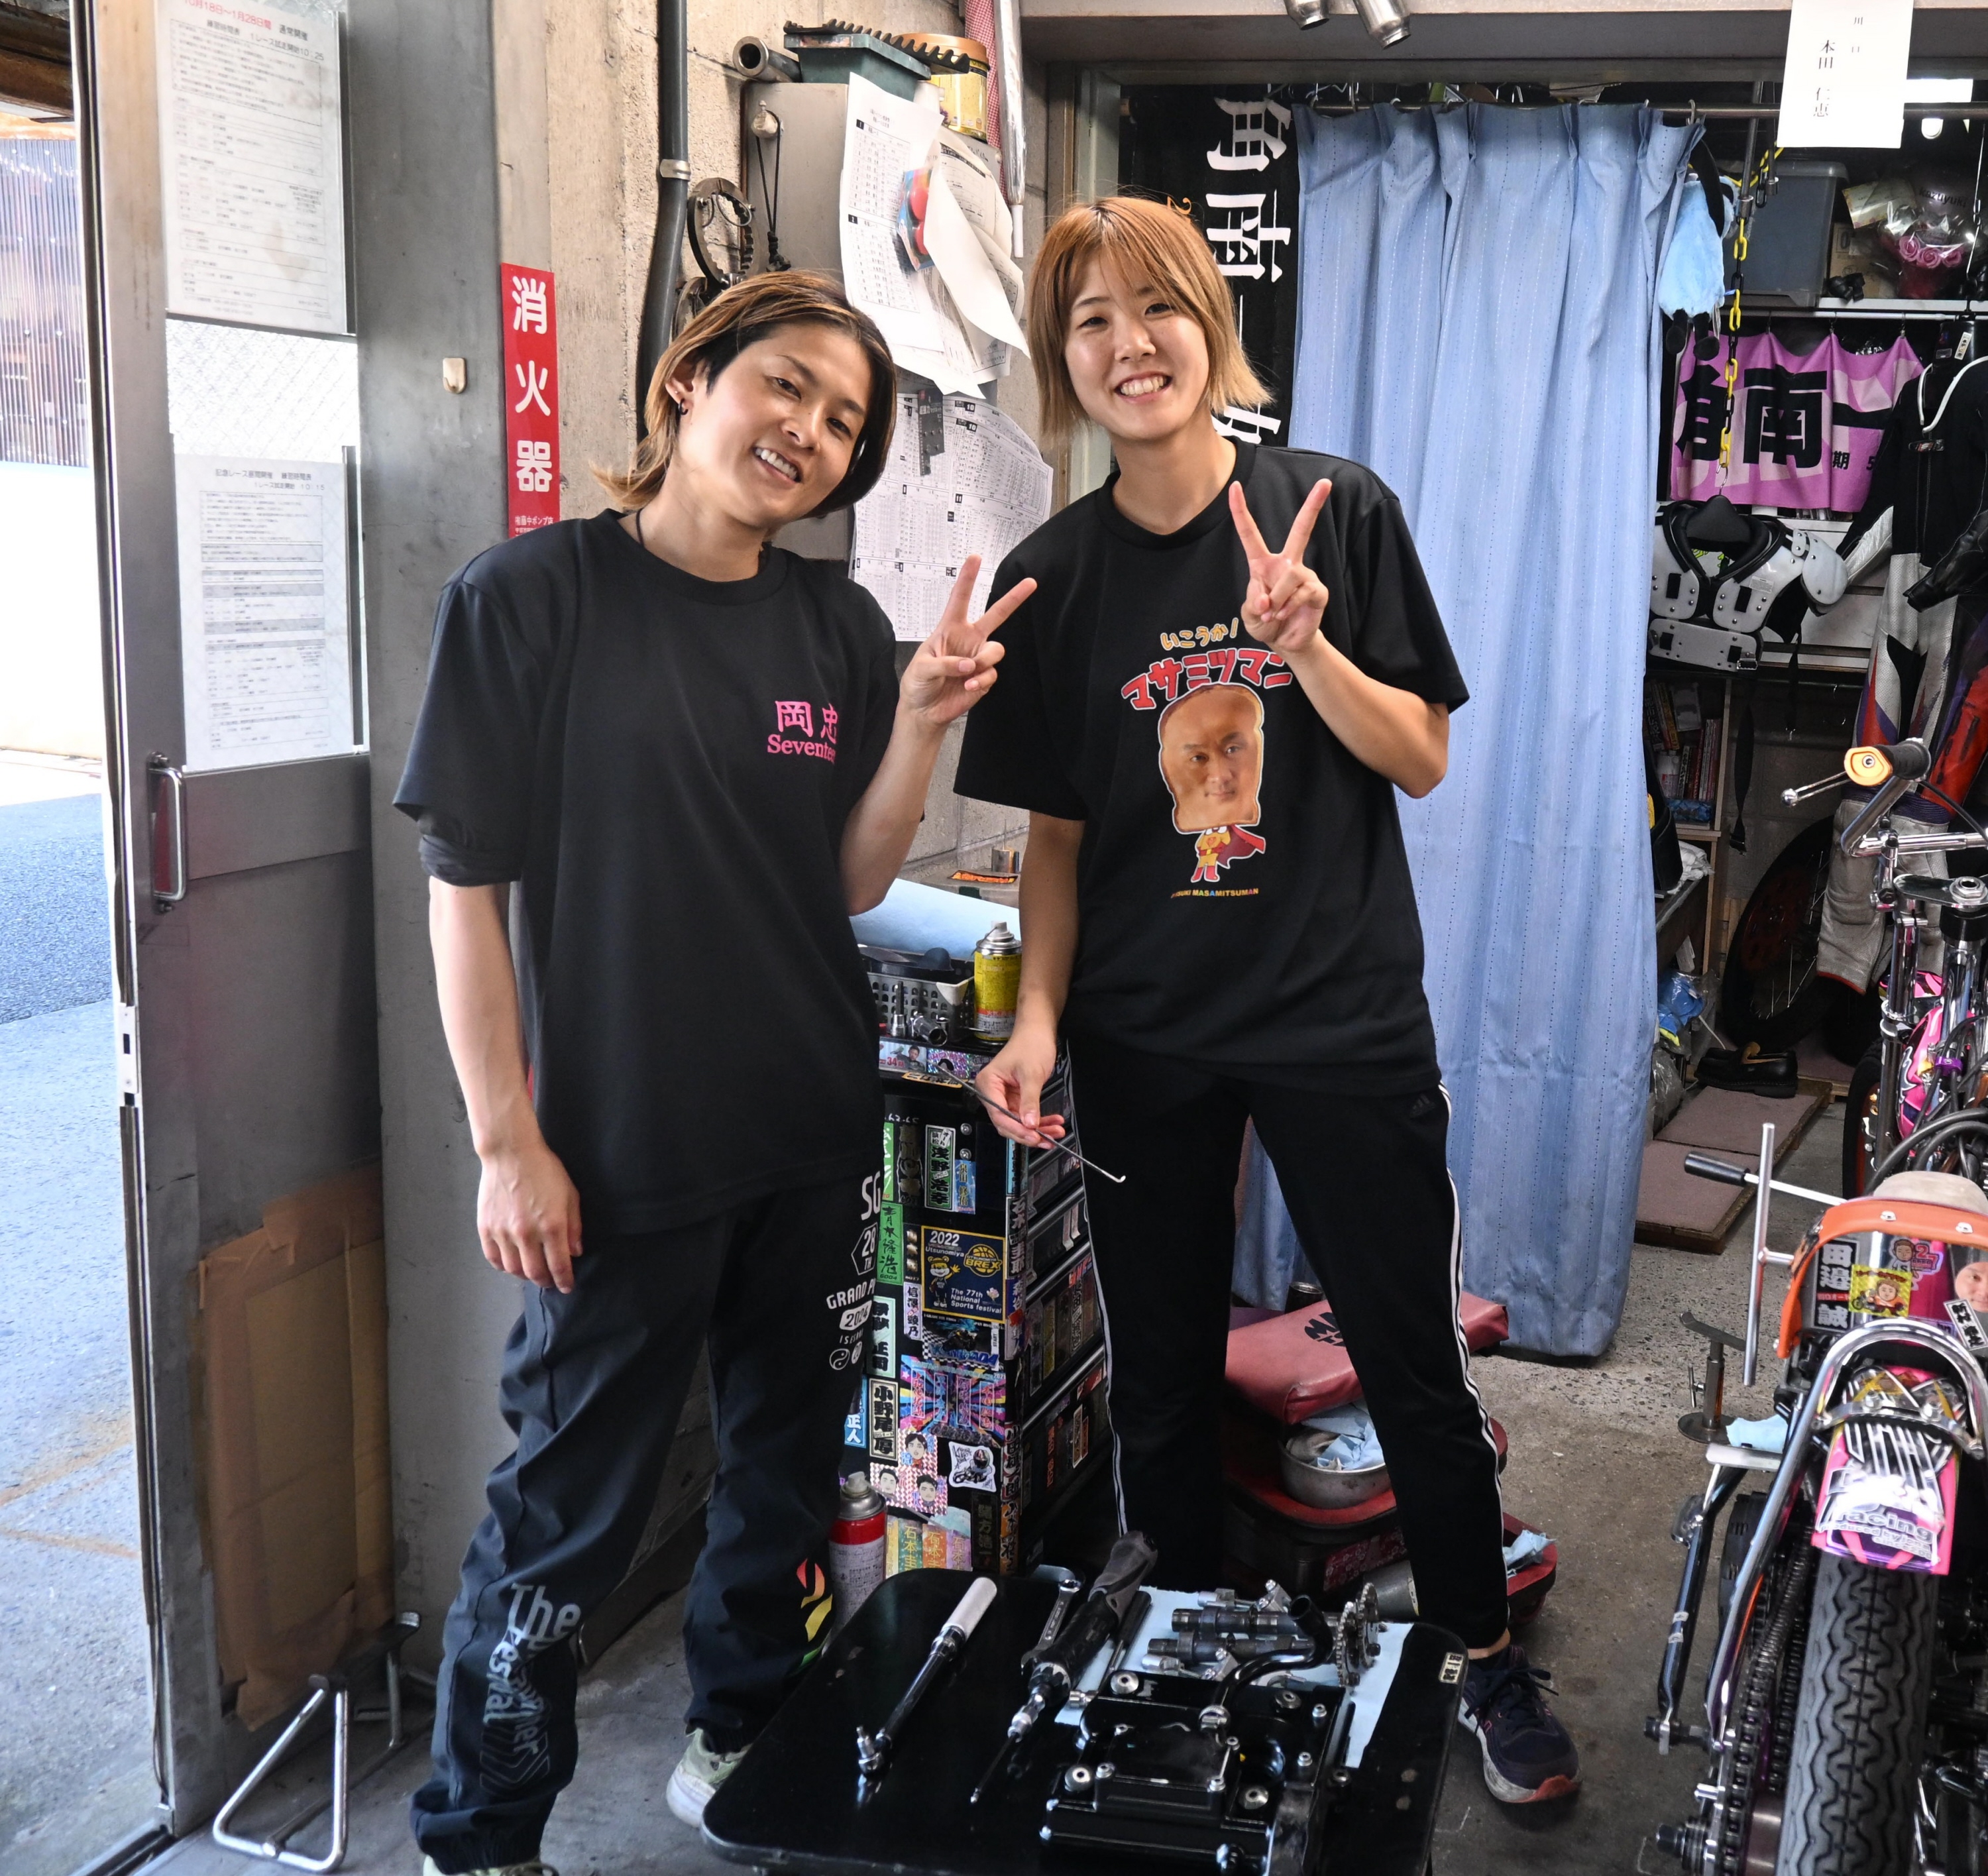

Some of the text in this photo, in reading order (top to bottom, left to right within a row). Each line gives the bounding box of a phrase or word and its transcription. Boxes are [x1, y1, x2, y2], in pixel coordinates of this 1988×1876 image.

[512, 275, 553, 493] 消火器
[1121, 647, 1293, 710] マサミツマン
[1192, 888, 1259, 897] MASAMITSUMAN
[861, 1170, 881, 1221] SG
[861, 1227, 877, 1258] 28
[930, 1230, 960, 1247] 2022
[925, 1245, 964, 1258] Utsunomiya
[863, 1256, 872, 1272] TH
[965, 1258, 1003, 1270] BREX
[826, 1280, 868, 1310] GRAND
[950, 1294, 980, 1304] National
[966, 1289, 983, 1298] 77th
[951, 1300, 1002, 1314] Sports festival
[846, 1304, 869, 1328] 2024
[508, 1582, 582, 1638] The
